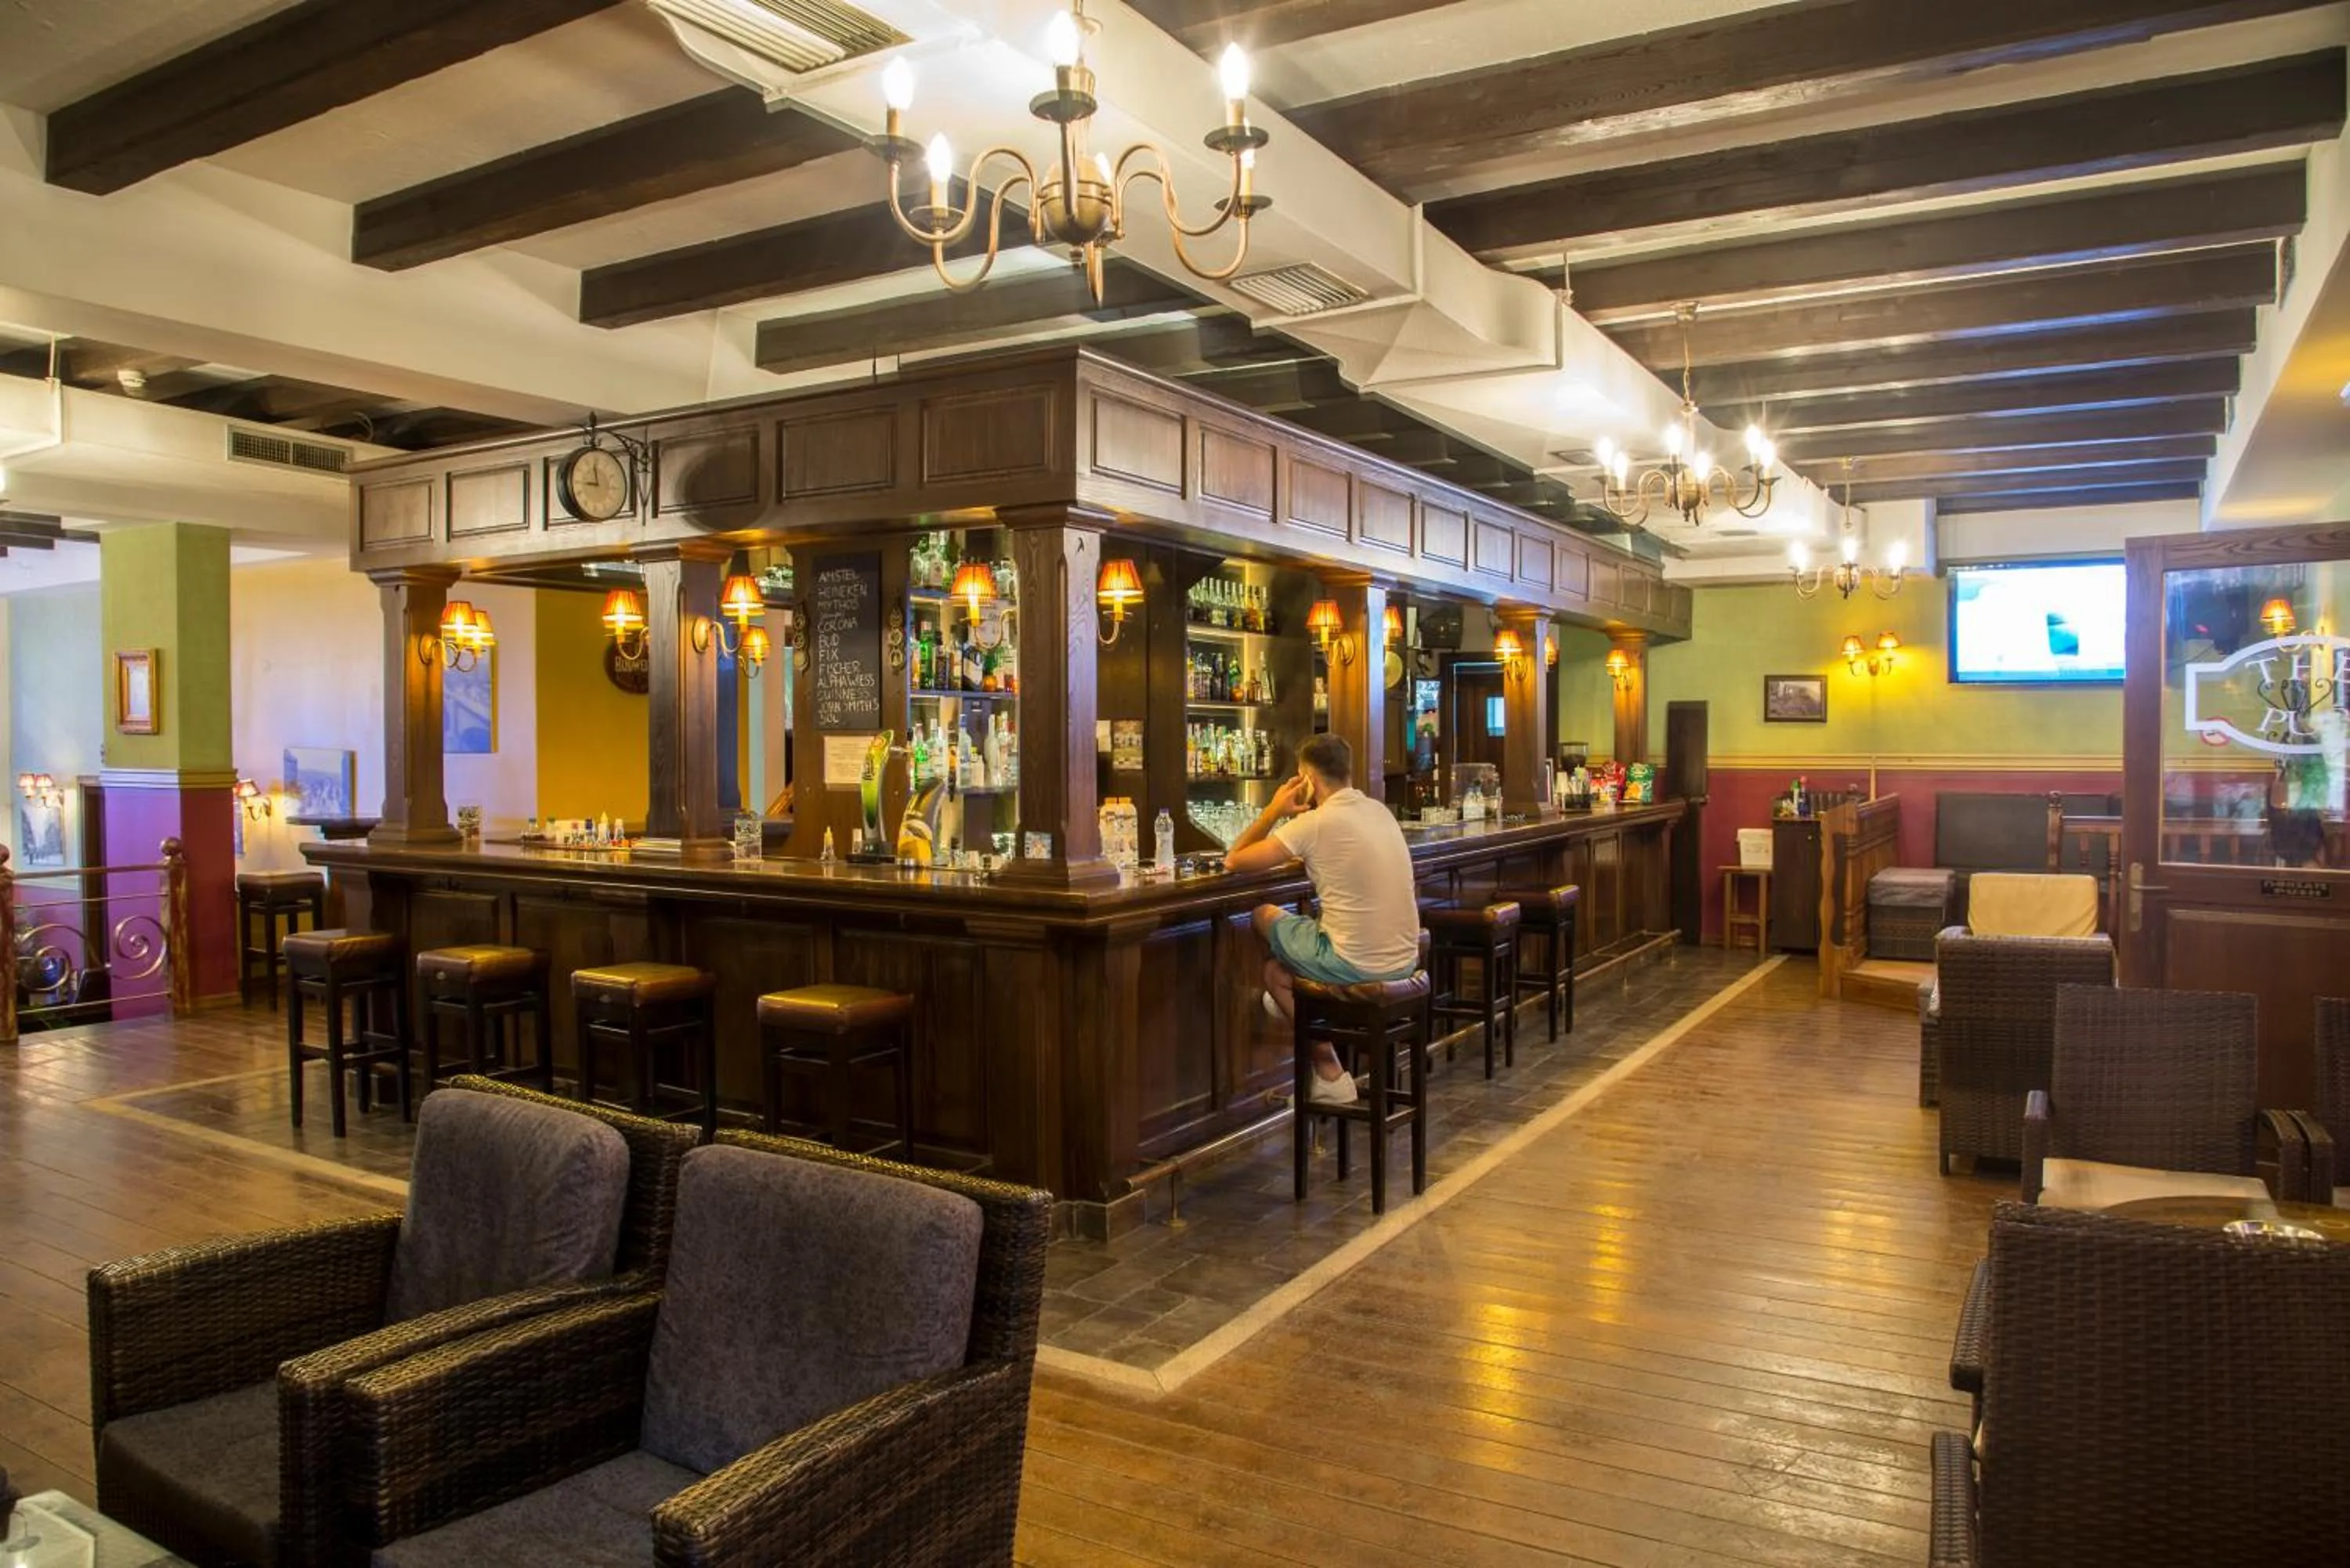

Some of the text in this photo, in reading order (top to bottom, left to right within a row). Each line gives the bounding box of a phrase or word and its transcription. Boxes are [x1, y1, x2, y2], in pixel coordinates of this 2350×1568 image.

[818, 569, 861, 583] AMSTEL
[817, 616, 858, 634] CORONA
[819, 633, 840, 649] BUD
[819, 648, 839, 662] FIX
